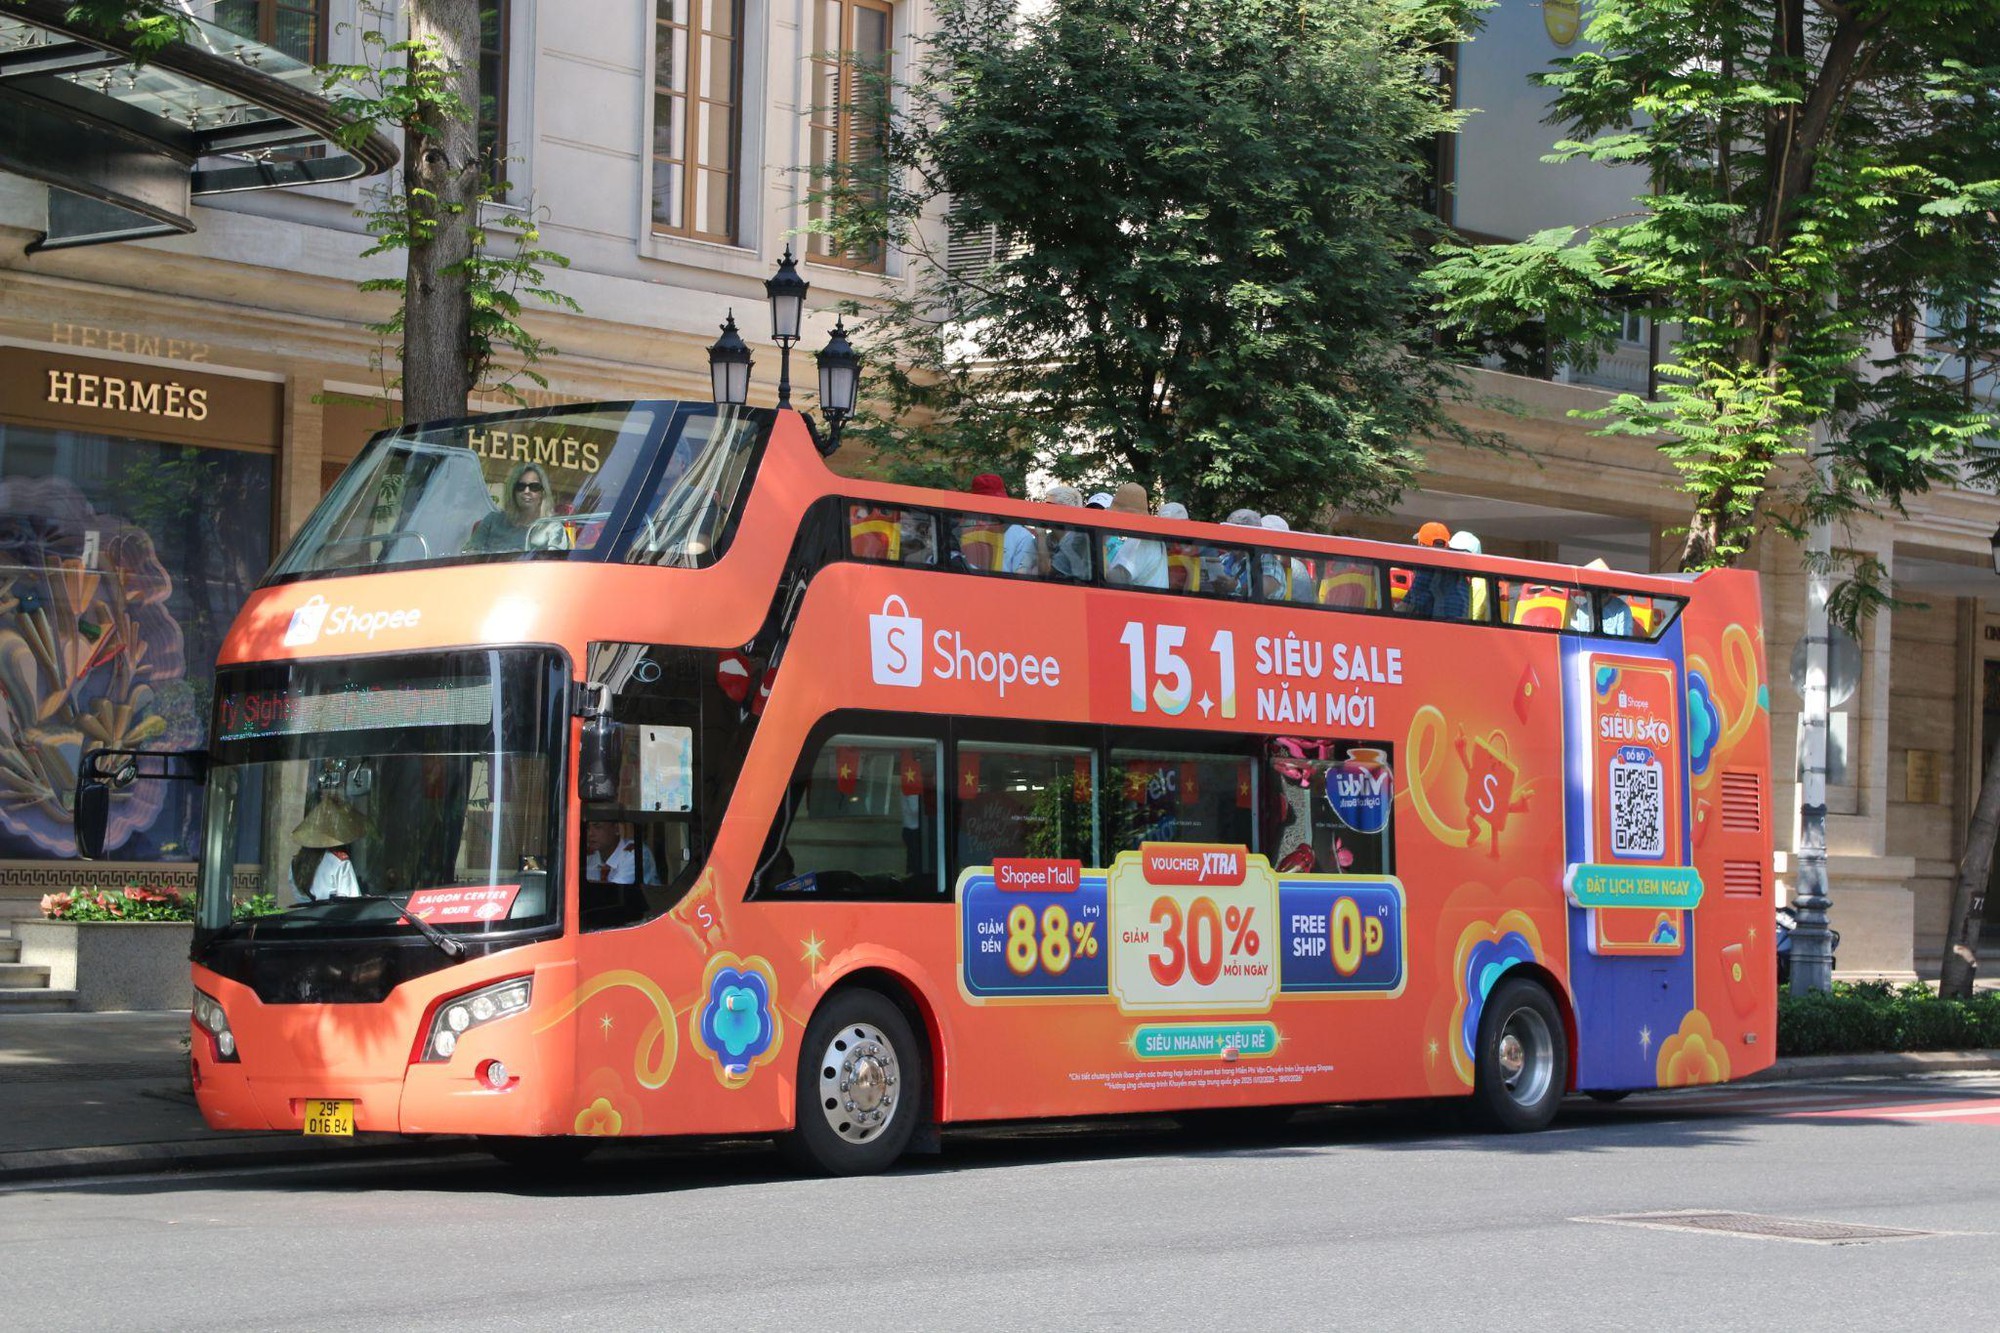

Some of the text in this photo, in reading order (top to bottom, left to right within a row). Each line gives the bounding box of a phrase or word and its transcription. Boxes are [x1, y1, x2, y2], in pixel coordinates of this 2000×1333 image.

[47, 369, 209, 422] HERMÈS
[325, 605, 422, 640] Shopee
[932, 629, 1060, 698] Shopee
[1254, 630, 1403, 685] SIÊU SALE
[1257, 681, 1375, 728] NĂM MỚI
[1600, 712, 1634, 740] SIÊU
[1001, 865, 1075, 889] Shopee Mall
[1150, 851, 1239, 882] VOUCHER XTRA
[417, 889, 508, 904] SAIGON CENTER
[1636, 879, 1659, 895] XEM
[1662, 880, 1690, 896] NGAY
[977, 917, 1004, 935] GIẢM
[1122, 926, 1149, 944] GIẢM
[1291, 915, 1326, 934] FREE
[981, 935, 1002, 953] ĐẾN
[1292, 937, 1327, 957] SHIP
[1145, 1029, 1265, 1051] SIÊU NHANH SIÊU RẺ
[319, 1101, 340, 1117] 29F
[309, 1119, 348, 1134] 016.84
